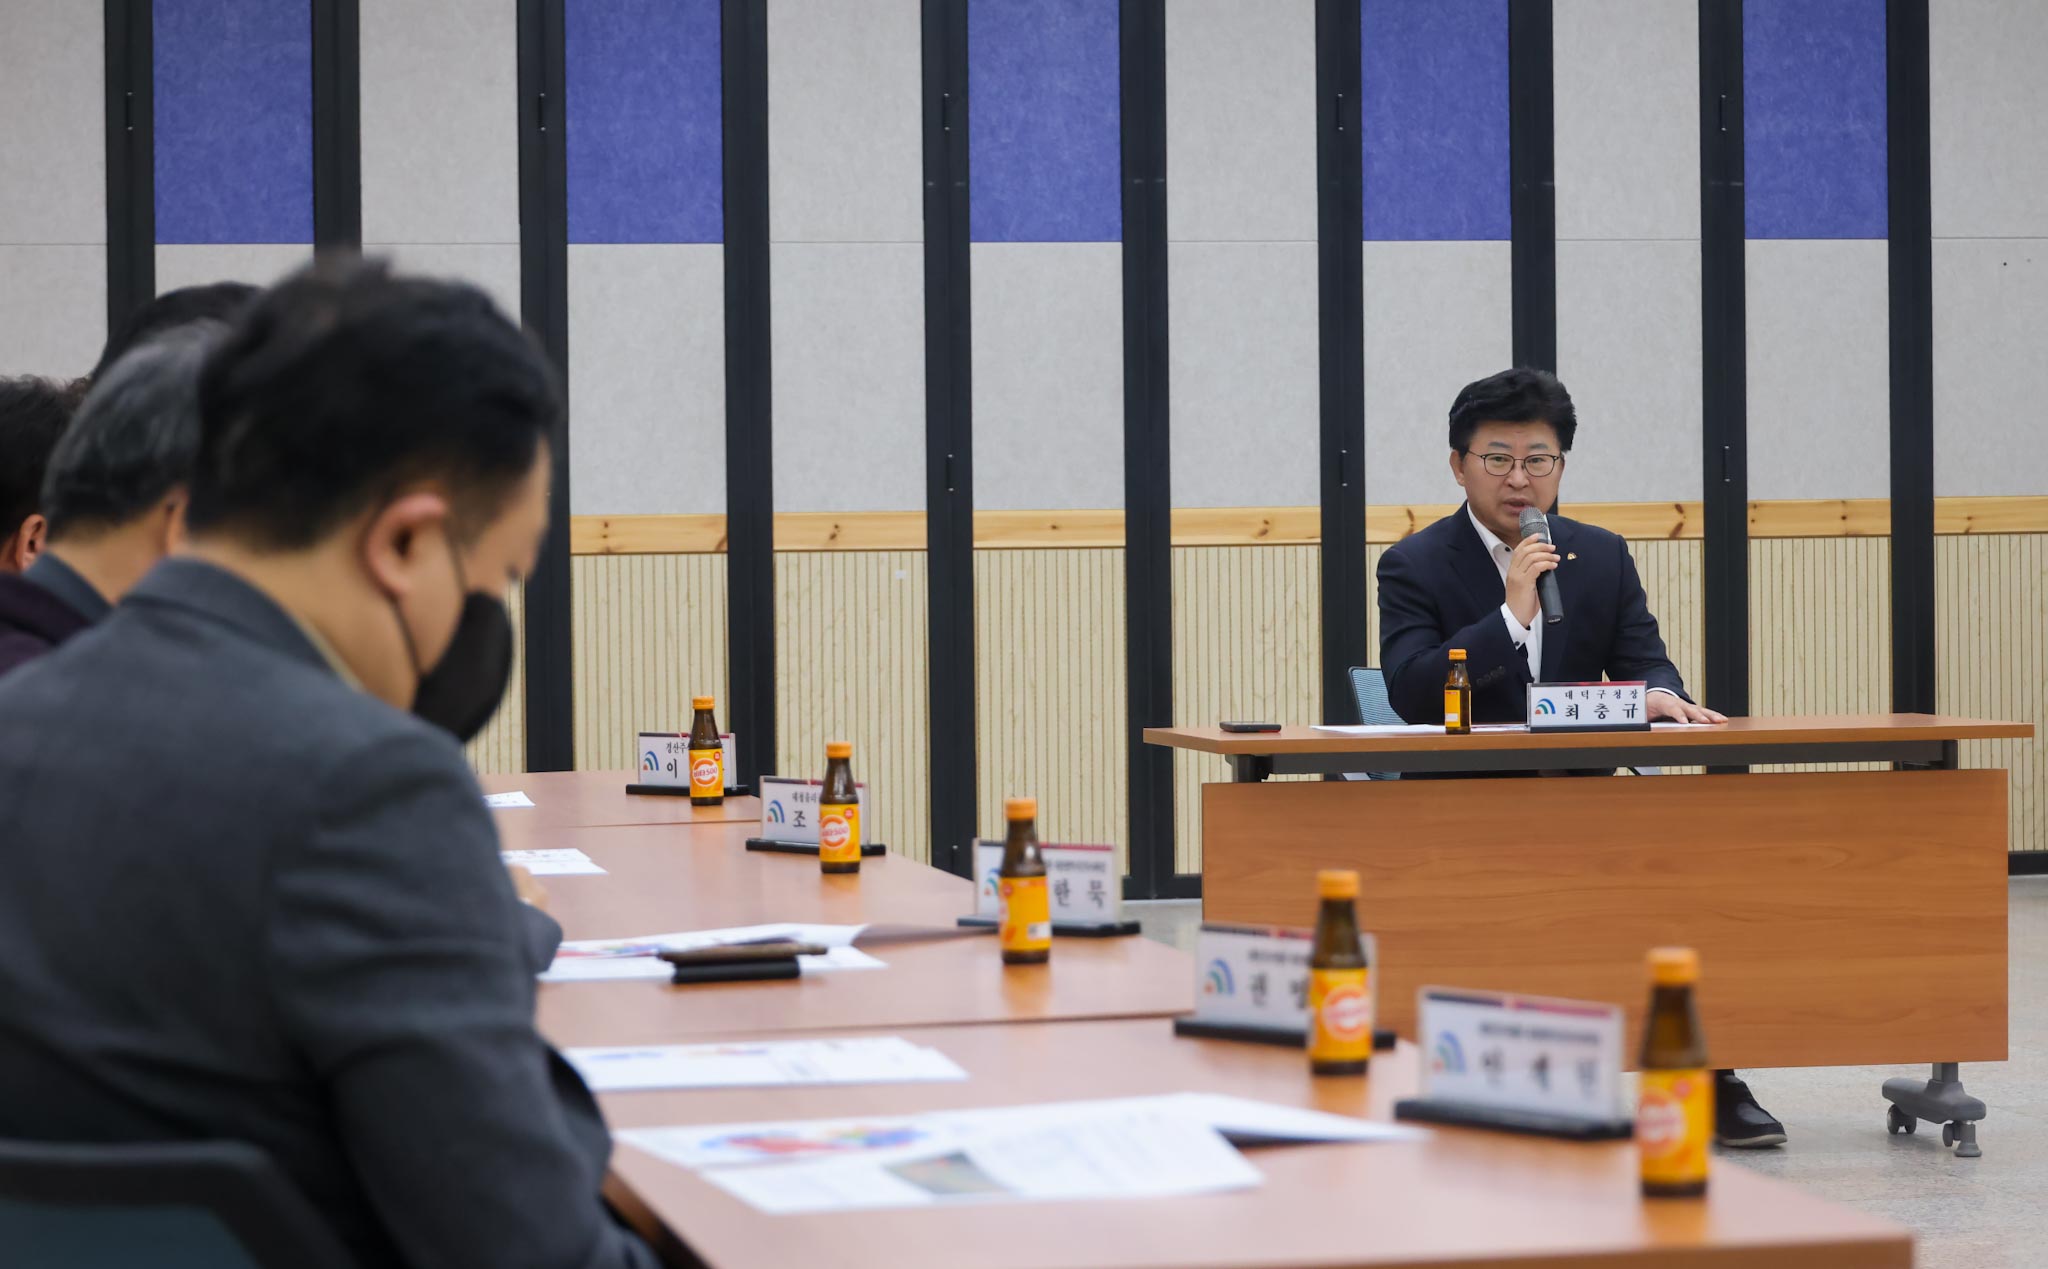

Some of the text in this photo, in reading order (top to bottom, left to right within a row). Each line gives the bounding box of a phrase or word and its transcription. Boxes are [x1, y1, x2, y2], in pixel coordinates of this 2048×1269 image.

[1564, 689, 1638, 700] 대덕구청장
[1565, 703, 1639, 720] 최충규
[666, 758, 678, 779] 이
[792, 810, 807, 828] 조
